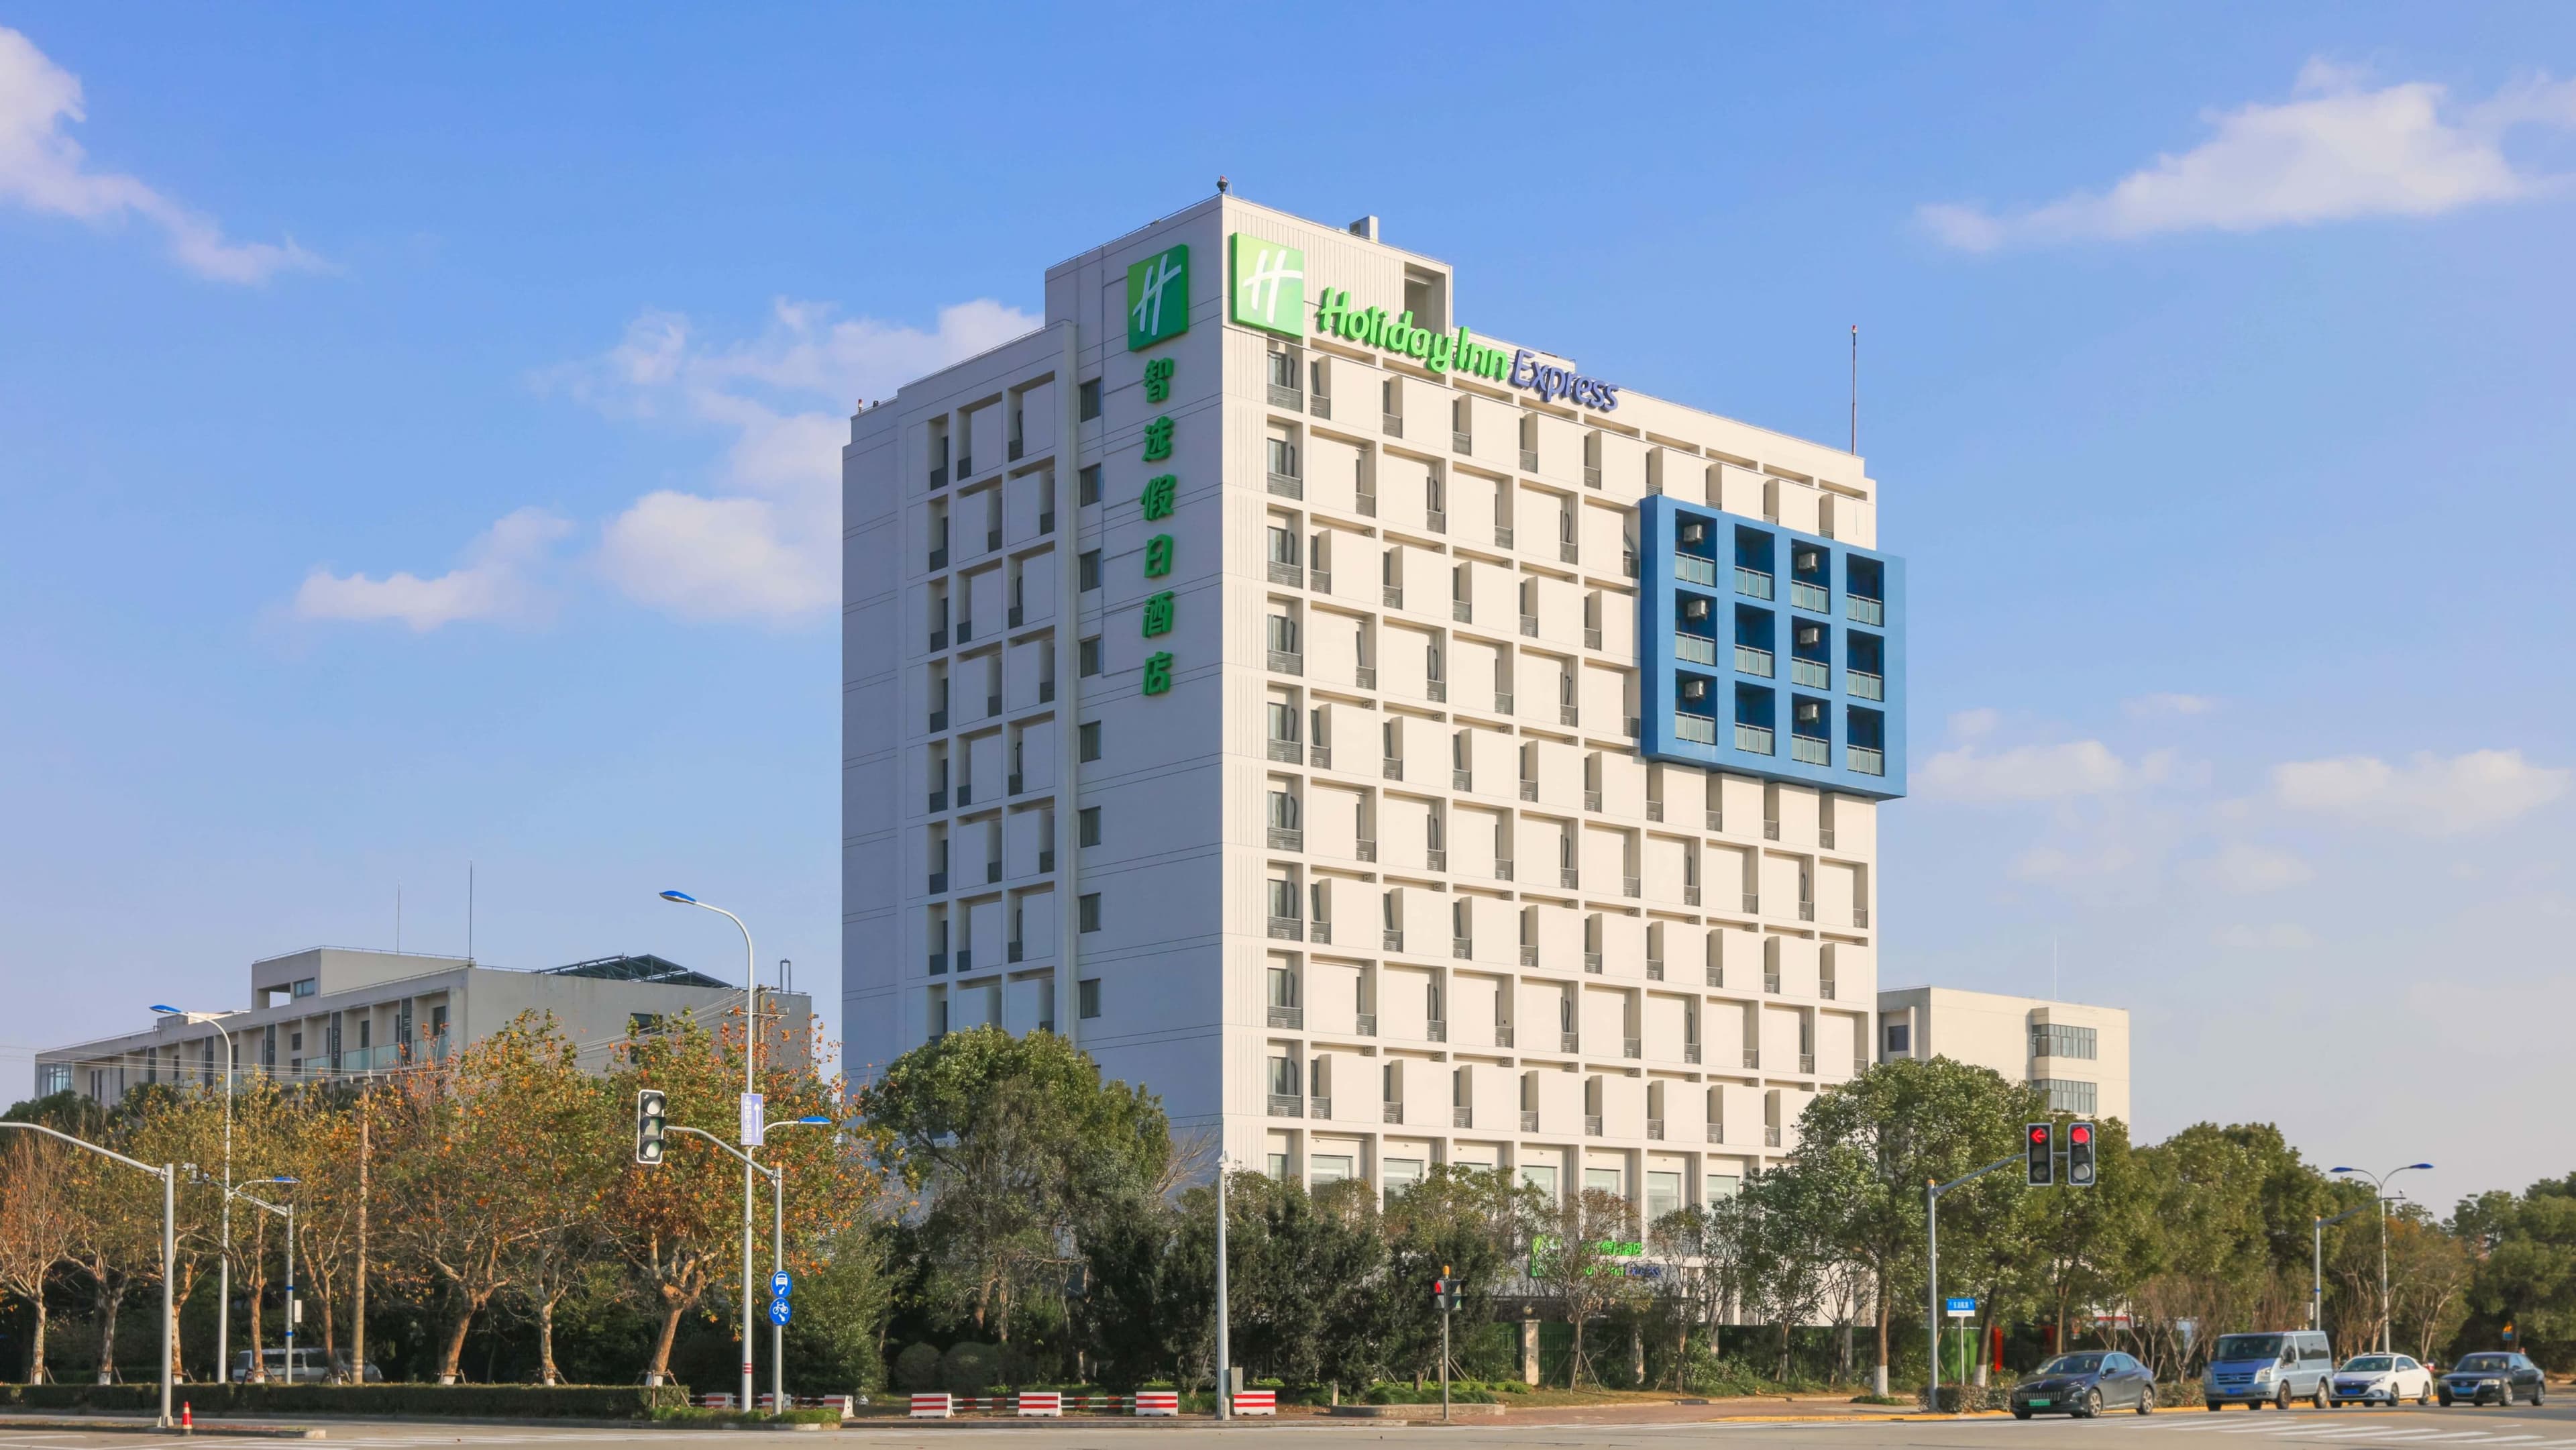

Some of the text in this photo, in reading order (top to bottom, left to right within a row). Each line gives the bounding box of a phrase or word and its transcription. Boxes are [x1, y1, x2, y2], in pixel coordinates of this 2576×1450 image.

[1316, 287, 1619, 411] Holiday Inn Express
[1140, 357, 1177, 696] 智选假日酒店
